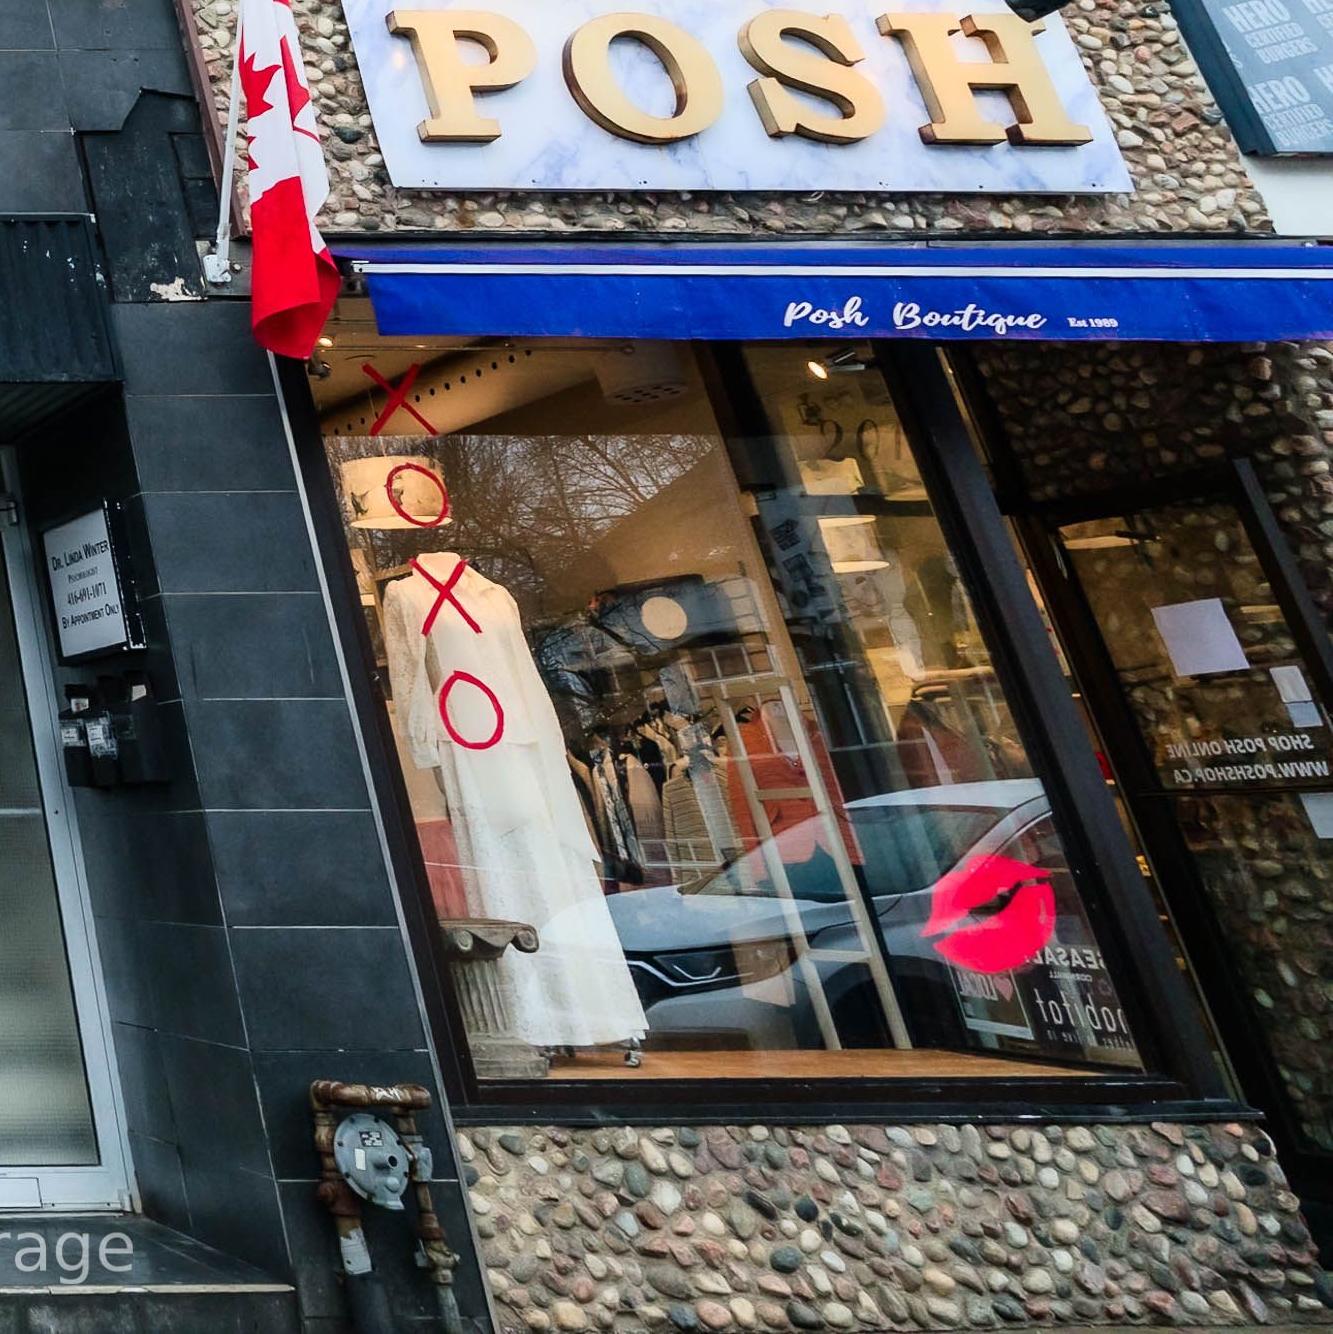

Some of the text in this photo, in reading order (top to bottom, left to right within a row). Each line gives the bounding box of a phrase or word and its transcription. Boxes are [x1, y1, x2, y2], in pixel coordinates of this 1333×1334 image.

[1244, 22, 1306, 48] CERTIFIED
[1255, 37, 1318, 64] BURGERS
[385, 9, 1094, 147] POSH
[783, 296, 1119, 335] Posh Boutique Est 1989
[64, 551, 83, 566] LINDA
[83, 540, 109, 559] WINTER
